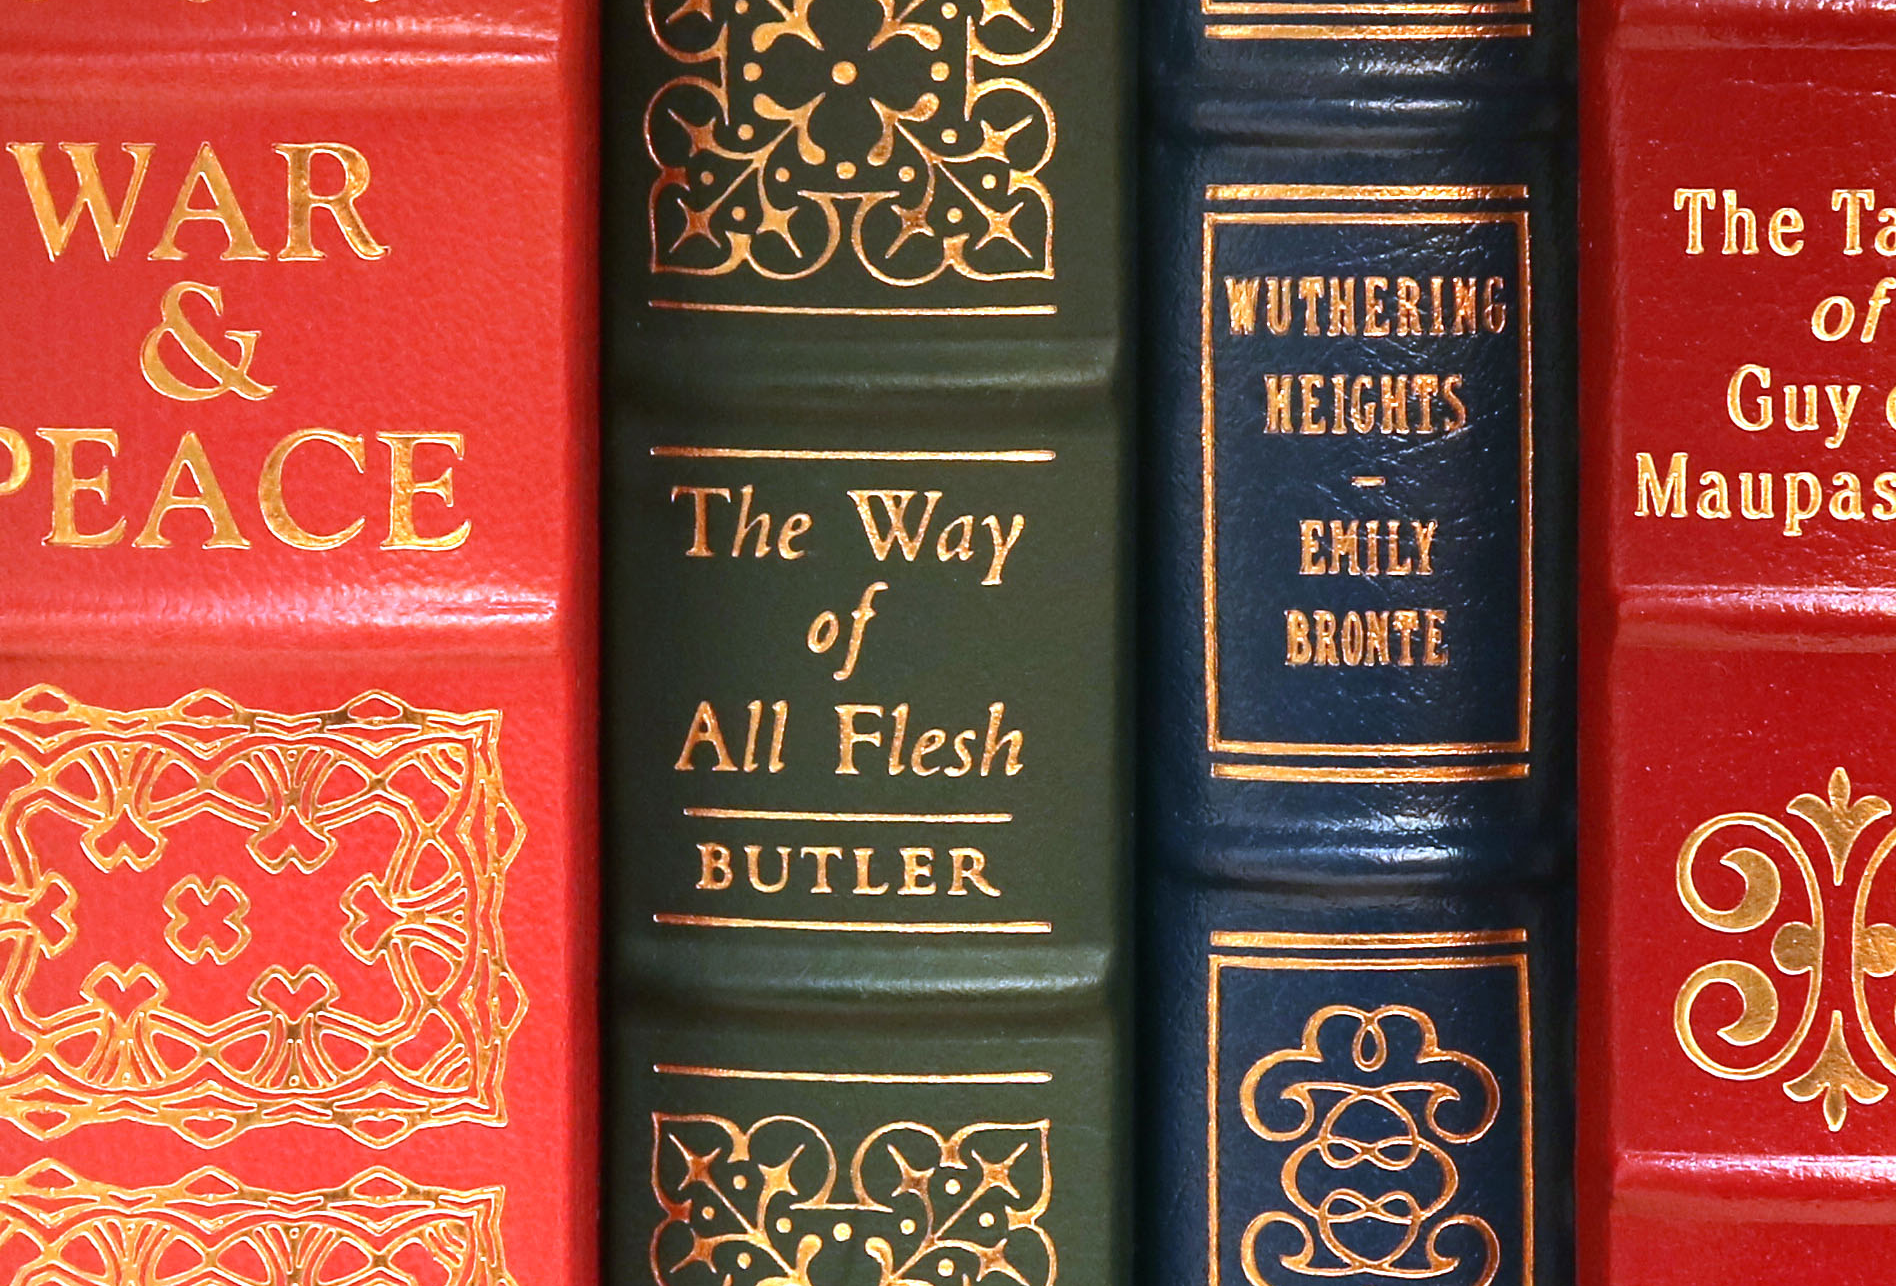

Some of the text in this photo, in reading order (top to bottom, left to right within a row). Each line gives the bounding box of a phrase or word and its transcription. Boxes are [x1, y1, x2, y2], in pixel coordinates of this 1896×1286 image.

[5, 141, 392, 262] WAR
[1673, 187, 1806, 257] The
[139, 280, 277, 401] &
[1223, 275, 1508, 337] WUTHERING
[1263, 373, 1468, 435] HEIGHTS
[1726, 363, 1862, 450] Guy
[670, 484, 1025, 586] The Way
[1298, 519, 1439, 576] EMILY
[807, 581, 889, 681] of
[1284, 609, 1450, 667] BRONTE
[674, 700, 1024, 777] All Flesh
[695, 842, 1002, 898] BUTLER
